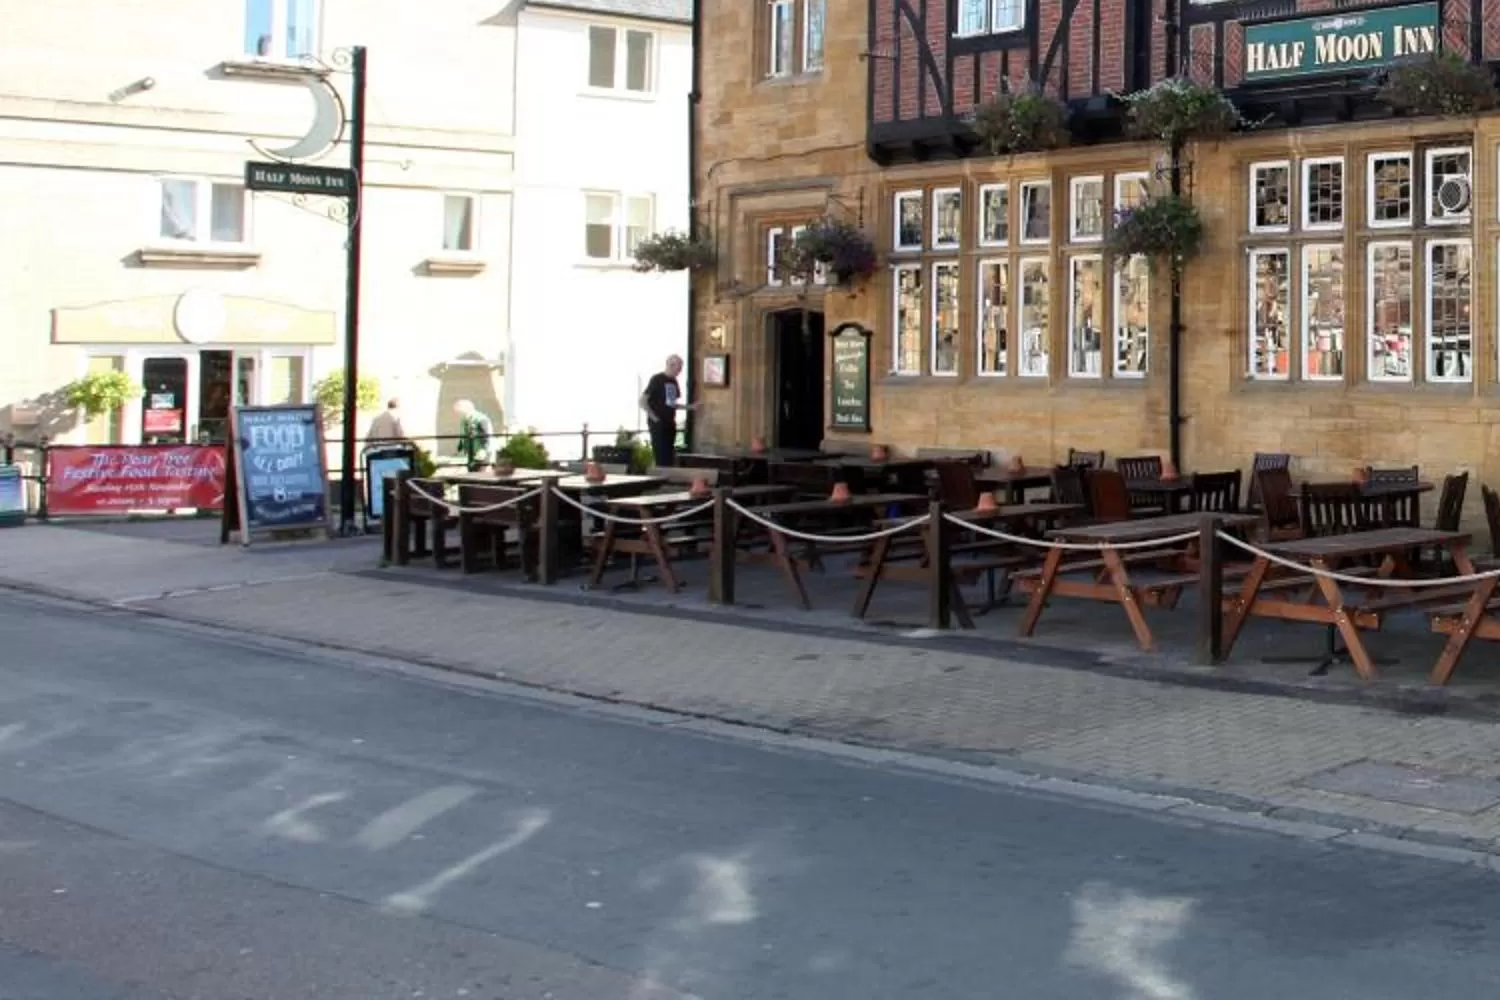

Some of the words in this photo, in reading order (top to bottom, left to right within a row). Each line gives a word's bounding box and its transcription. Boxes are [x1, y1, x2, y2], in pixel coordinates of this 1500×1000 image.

[1246, 41, 1305, 73] HALF
[1314, 31, 1383, 65] MOON
[1393, 25, 1435, 57] INN
[250, 424, 305, 449] FOOD
